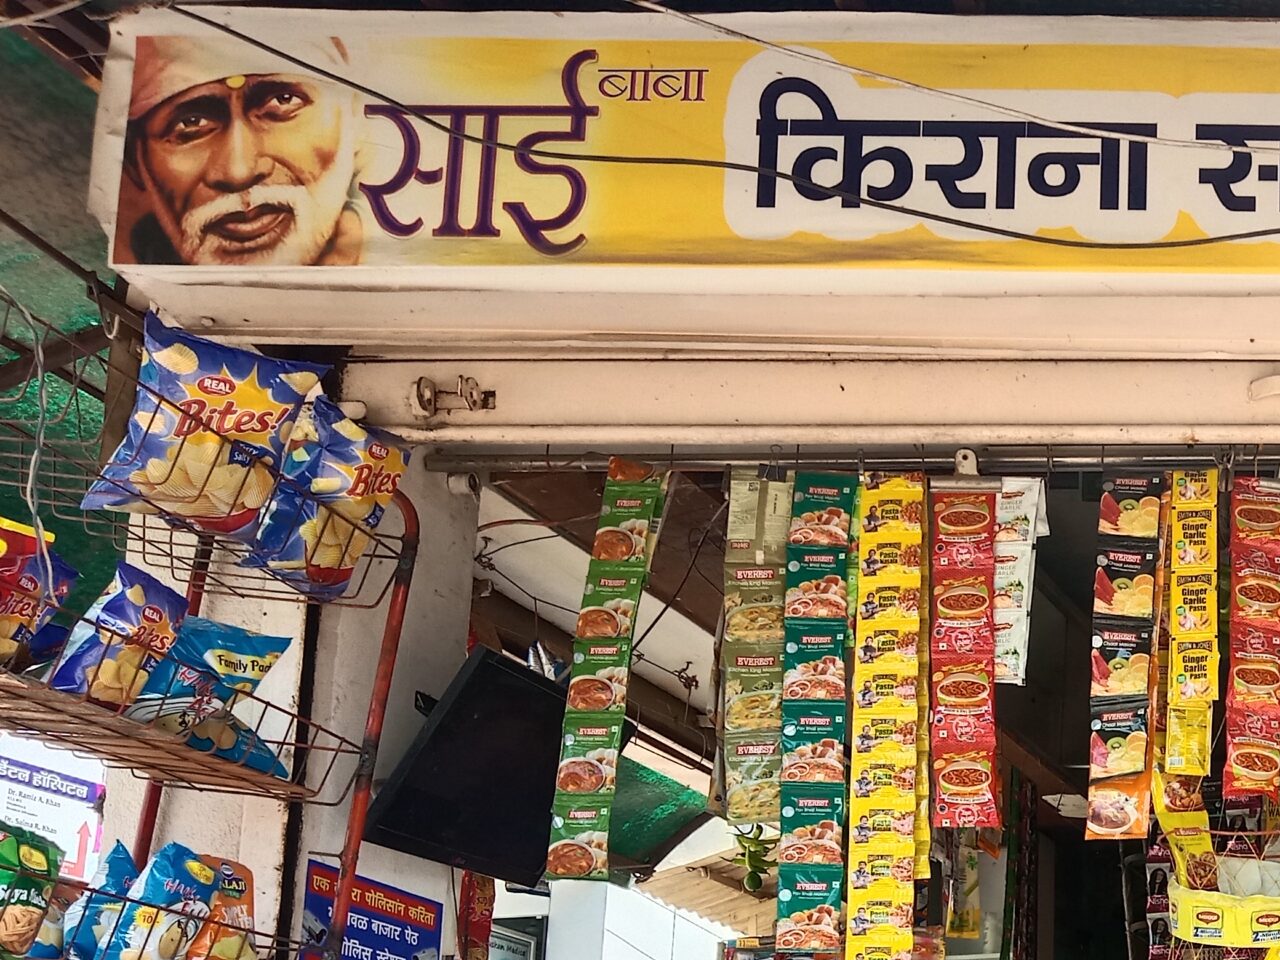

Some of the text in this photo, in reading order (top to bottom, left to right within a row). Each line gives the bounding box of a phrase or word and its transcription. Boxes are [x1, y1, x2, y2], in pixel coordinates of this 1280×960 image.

[756, 77, 1158, 211] किराना
[359, 49, 707, 256] साई बाबा
[204, 378, 232, 393] REAL
[173, 399, 291, 438] Bites!
[371, 444, 388, 458] REAL
[1182, 523, 1207, 531] Ginger
[1183, 531, 1206, 539] Garlic
[736, 570, 774, 579] EVEREST
[1182, 588, 1207, 596] Ginger
[1183, 596, 1206, 604] Garlic
[144, 607, 162, 622] REAL
[217, 655, 248, 673] Family
[736, 657, 775, 666] EVEREST
[1182, 655, 1208, 664] Ginger
[1184, 664, 1207, 672] Garlic
[313, 874, 330, 892] एक
[409, 904, 435, 926] करिता
[371, 918, 420, 946] बाजार पेठ
